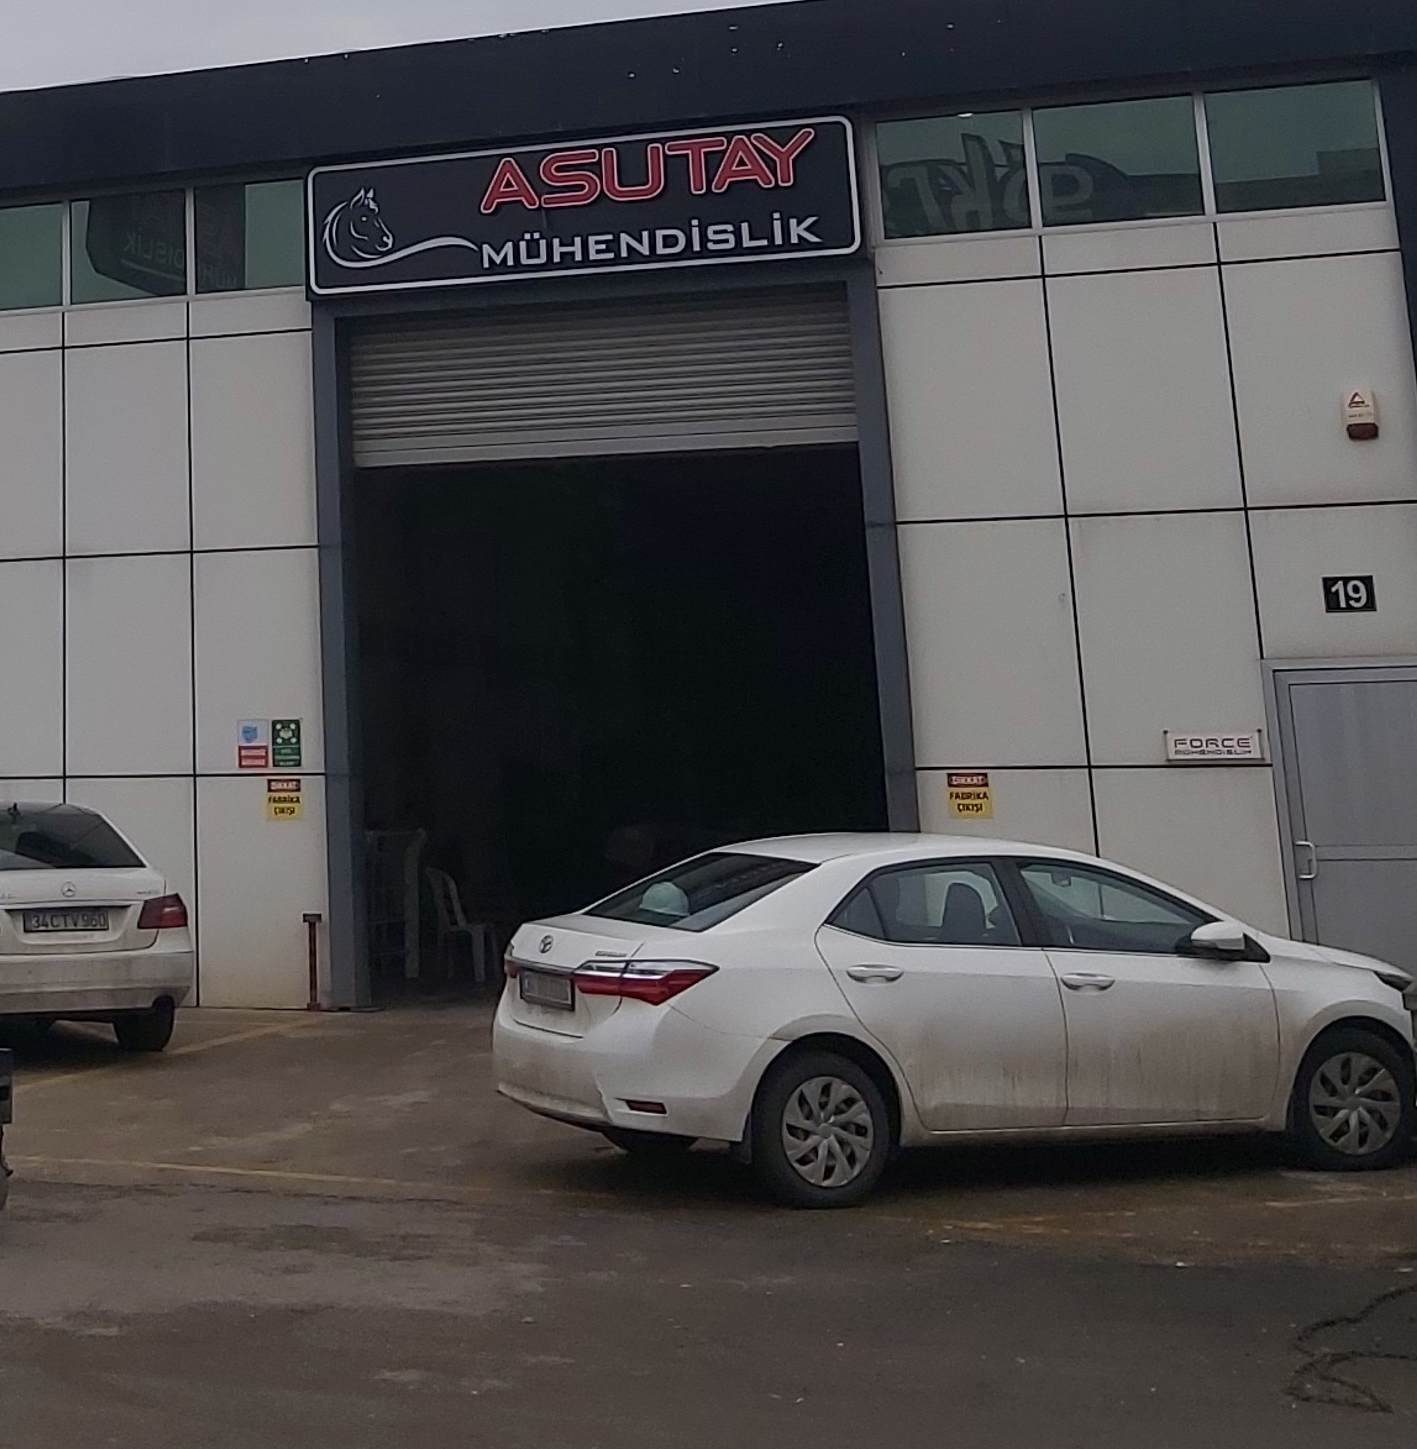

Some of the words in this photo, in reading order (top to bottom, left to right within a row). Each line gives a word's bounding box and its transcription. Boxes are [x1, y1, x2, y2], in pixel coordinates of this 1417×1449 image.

[481, 128, 815, 213] ASUTAY
[482, 212, 823, 269] MÜHENDİSLİK
[1330, 579, 1368, 608] 19
[1174, 737, 1252, 749] FORCE
